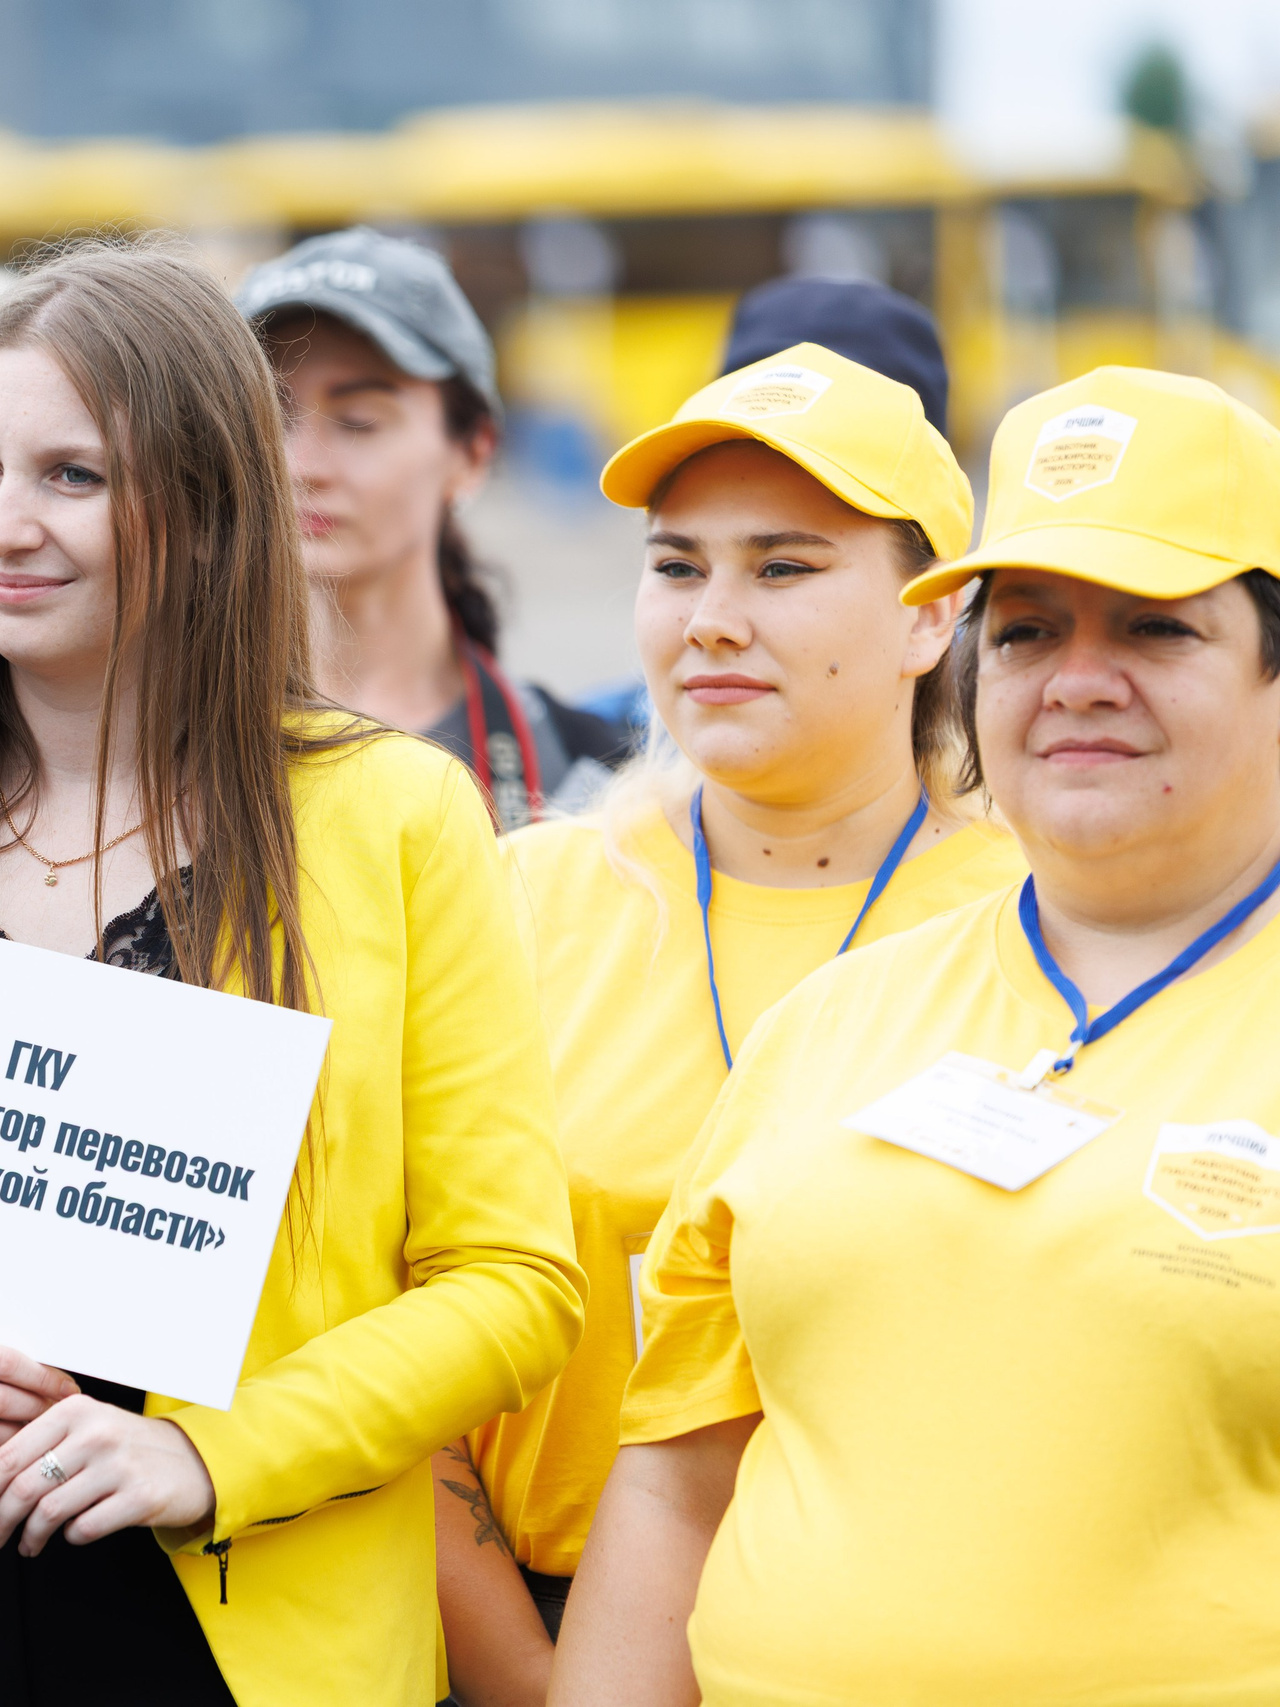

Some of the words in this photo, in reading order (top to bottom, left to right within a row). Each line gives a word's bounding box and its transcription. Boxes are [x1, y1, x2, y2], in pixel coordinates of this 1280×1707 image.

[1064, 415, 1106, 429] ЛУЧШИЙ
[5, 1039, 77, 1092] ГКУ
[53, 1121, 256, 1202] перевозок
[55, 1180, 226, 1253] области»
